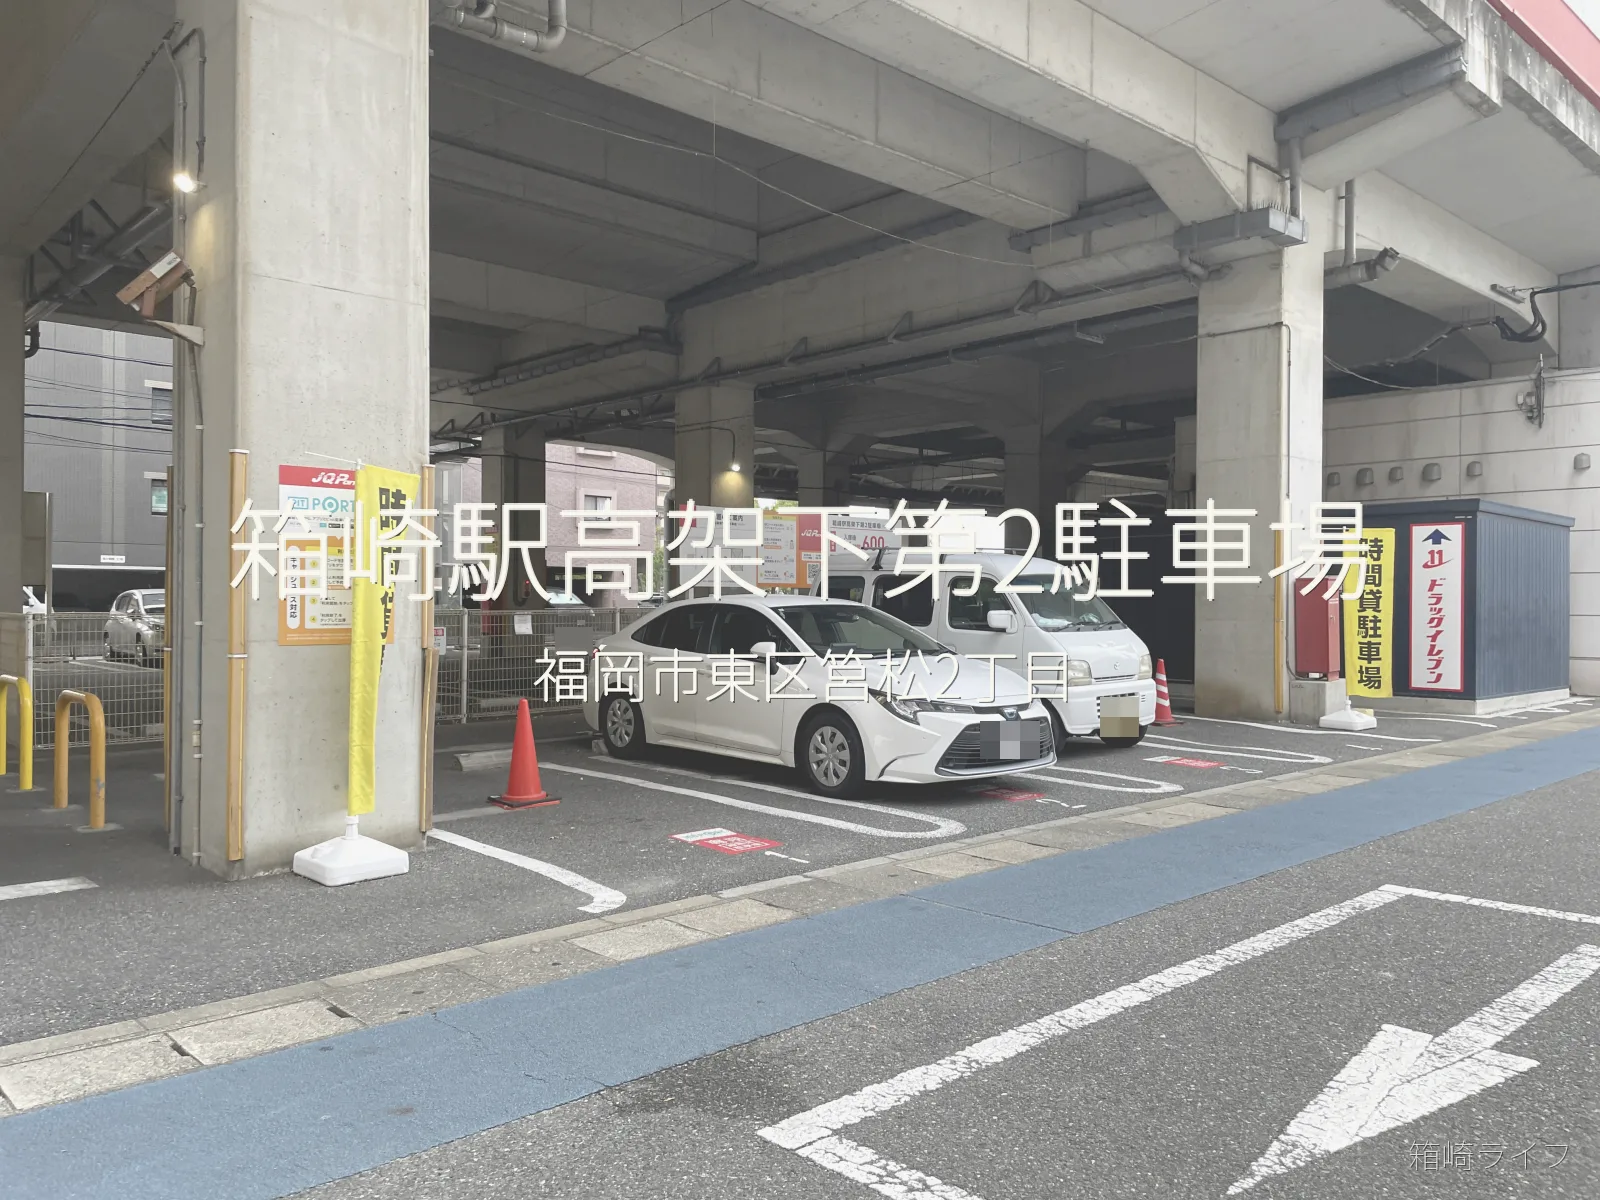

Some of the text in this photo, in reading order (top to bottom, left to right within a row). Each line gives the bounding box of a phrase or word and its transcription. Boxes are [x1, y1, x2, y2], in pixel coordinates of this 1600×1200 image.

[863, 536, 885, 551] 600
[1357, 537, 1383, 690] 時間貸駐車場
[1426, 578, 1446, 684] ドラッグイレブン
